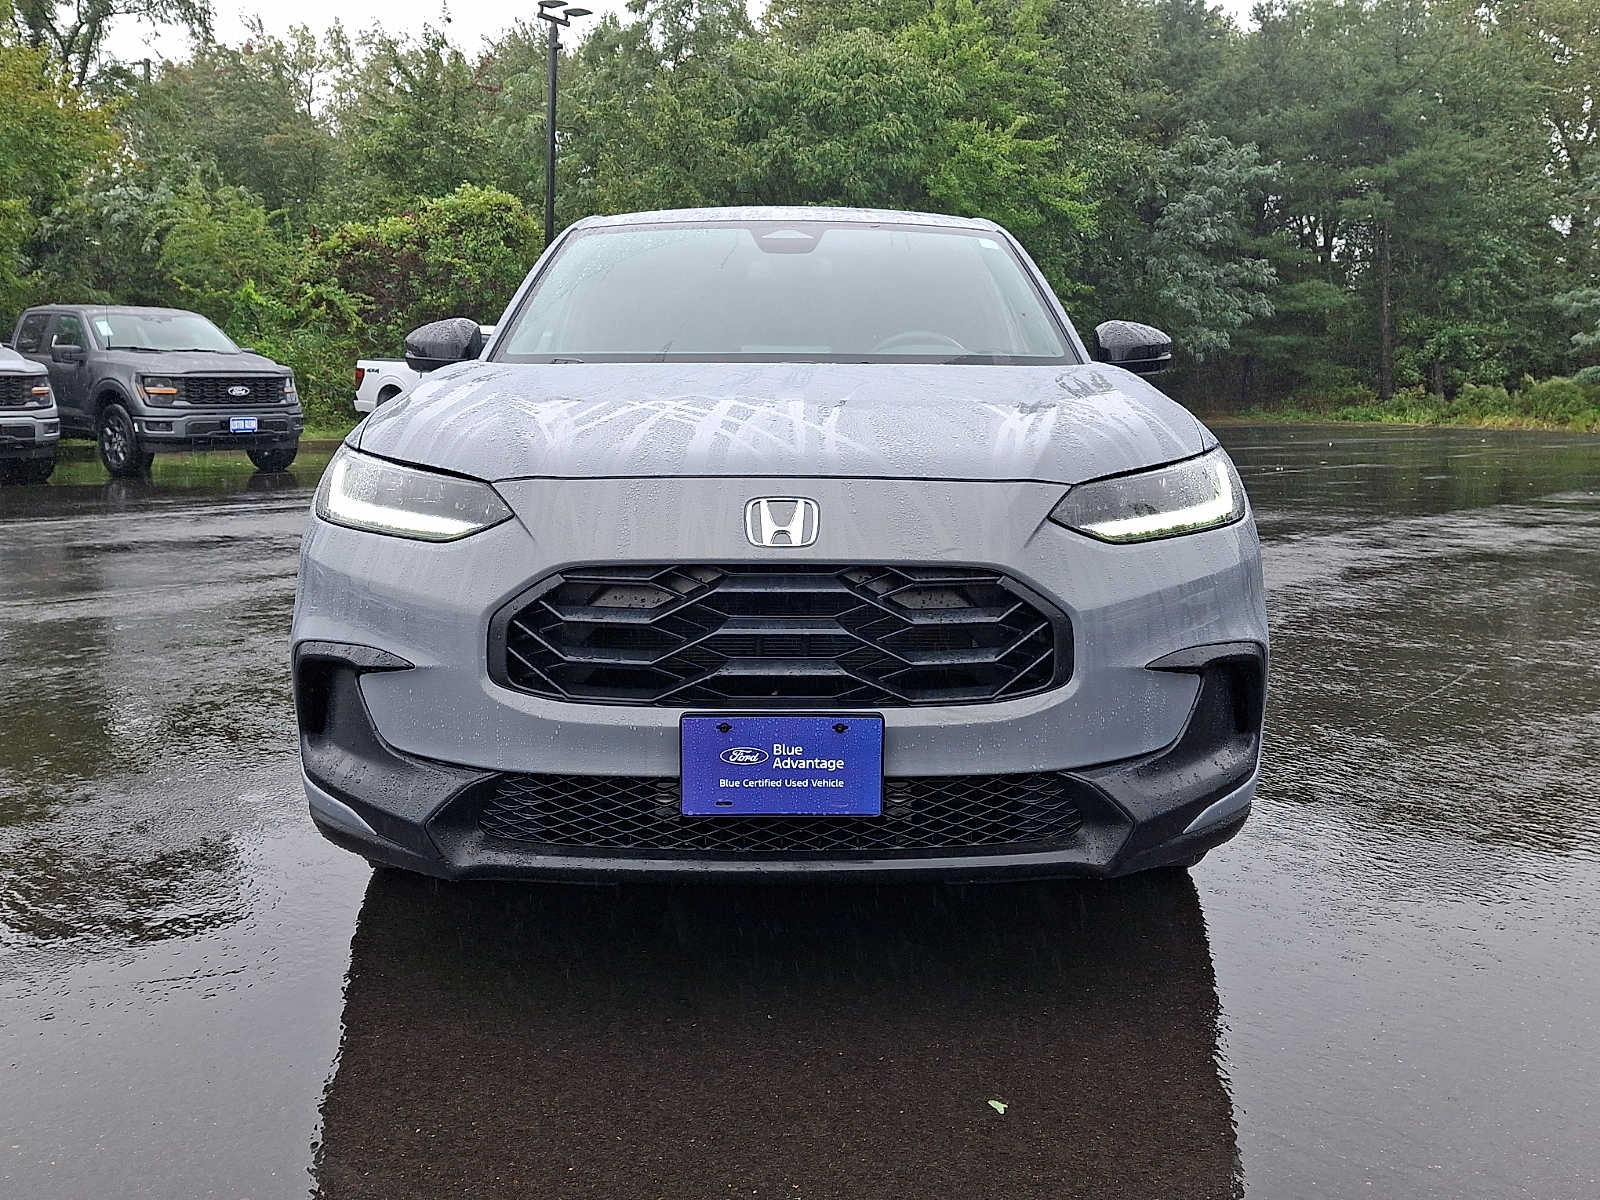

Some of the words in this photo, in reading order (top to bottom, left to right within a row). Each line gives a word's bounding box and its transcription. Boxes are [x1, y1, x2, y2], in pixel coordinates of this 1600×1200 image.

[728, 749, 759, 763] Ford
[773, 744, 803, 756] Blue
[772, 757, 845, 771] Advantage
[719, 779, 740, 788] Blue
[742, 778, 782, 788] Certified
[784, 779, 809, 788] Used
[811, 779, 845, 788] Vehicle
